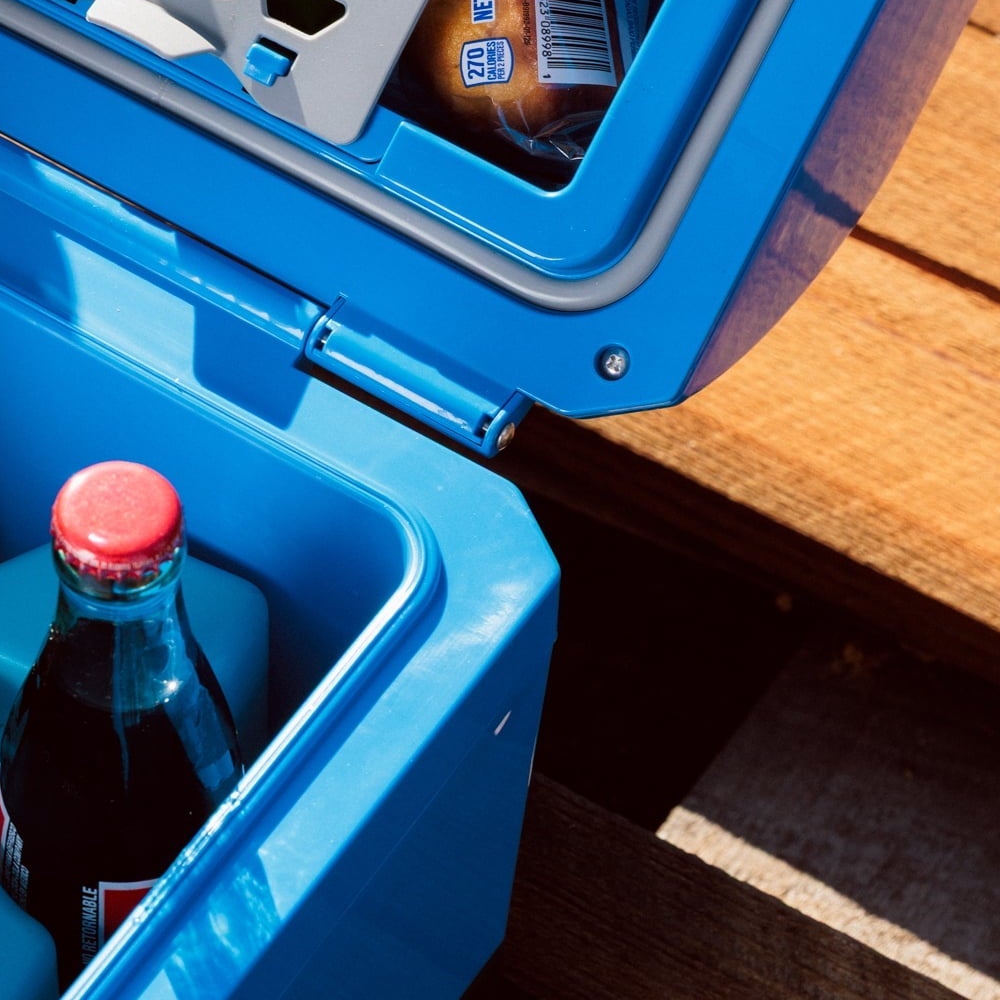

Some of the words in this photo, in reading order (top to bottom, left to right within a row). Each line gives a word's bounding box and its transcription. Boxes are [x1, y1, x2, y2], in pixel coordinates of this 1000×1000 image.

[496, 41, 505, 59] PIECES
[541, 21, 552, 57] 08998
[466, 47, 485, 80] 270
[486, 41, 497, 81] CALORIES
[497, 66, 505, 80] PER
[82, 886, 98, 953] RETORNABLE
